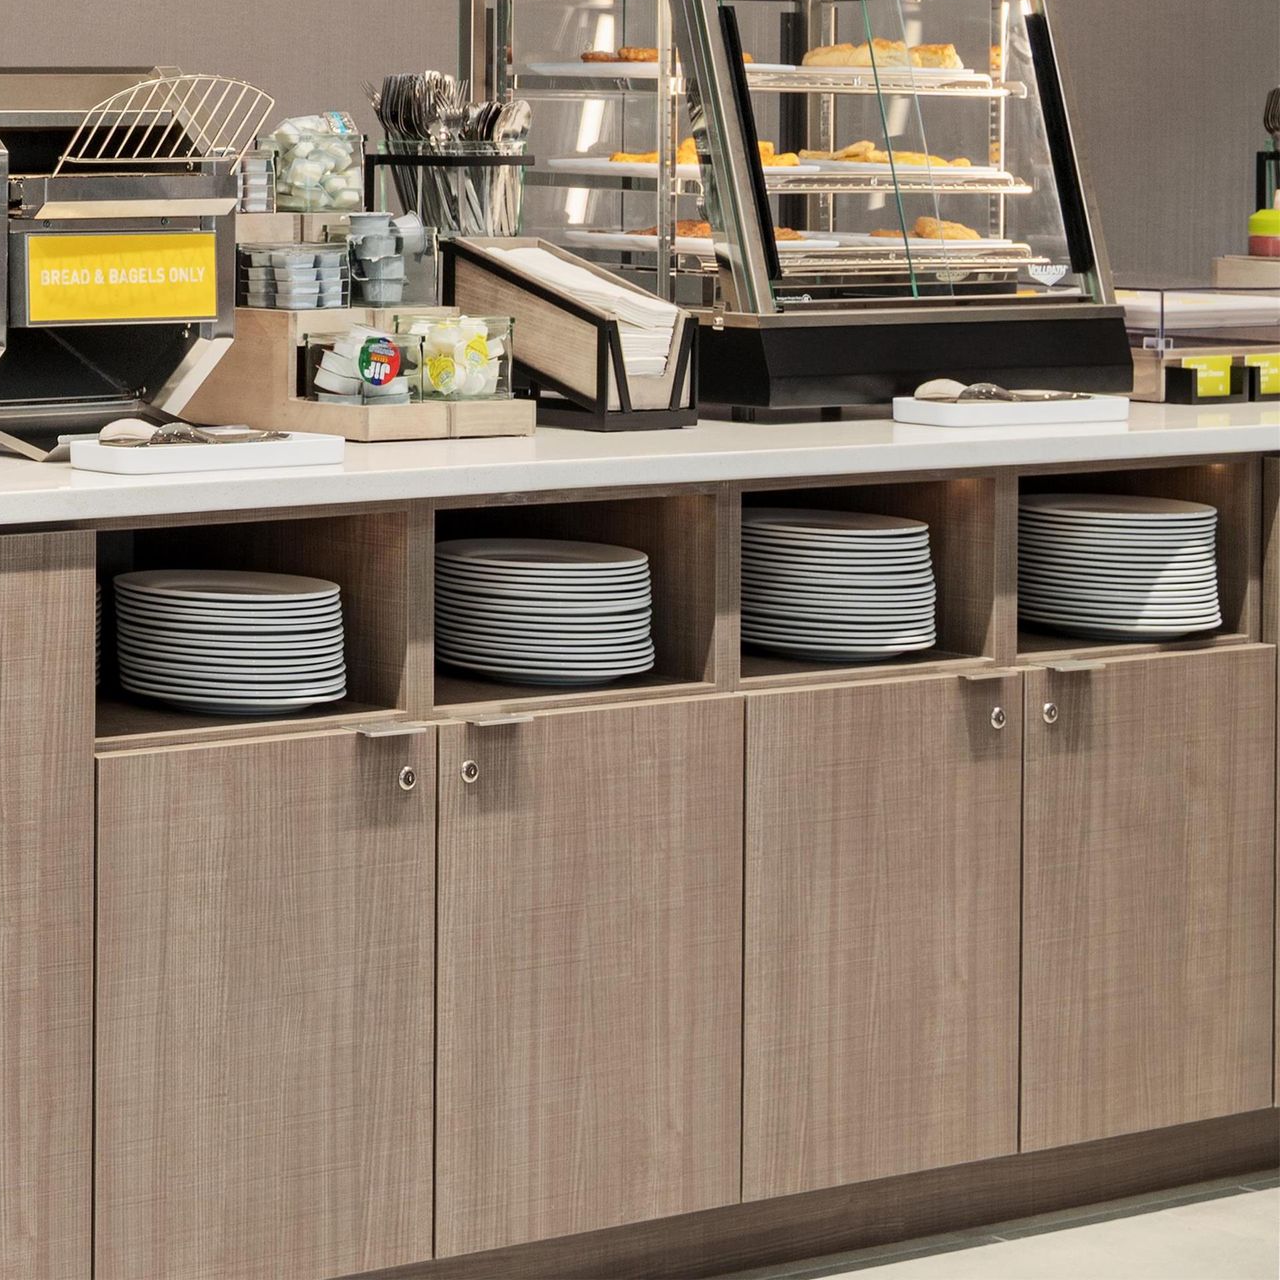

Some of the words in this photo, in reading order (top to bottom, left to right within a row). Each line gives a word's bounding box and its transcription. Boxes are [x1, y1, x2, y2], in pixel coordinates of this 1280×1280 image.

[40, 270, 90, 285] BREAD
[94, 269, 105, 284] &
[109, 268, 165, 284] BAGELS
[169, 266, 206, 283] ONLY
